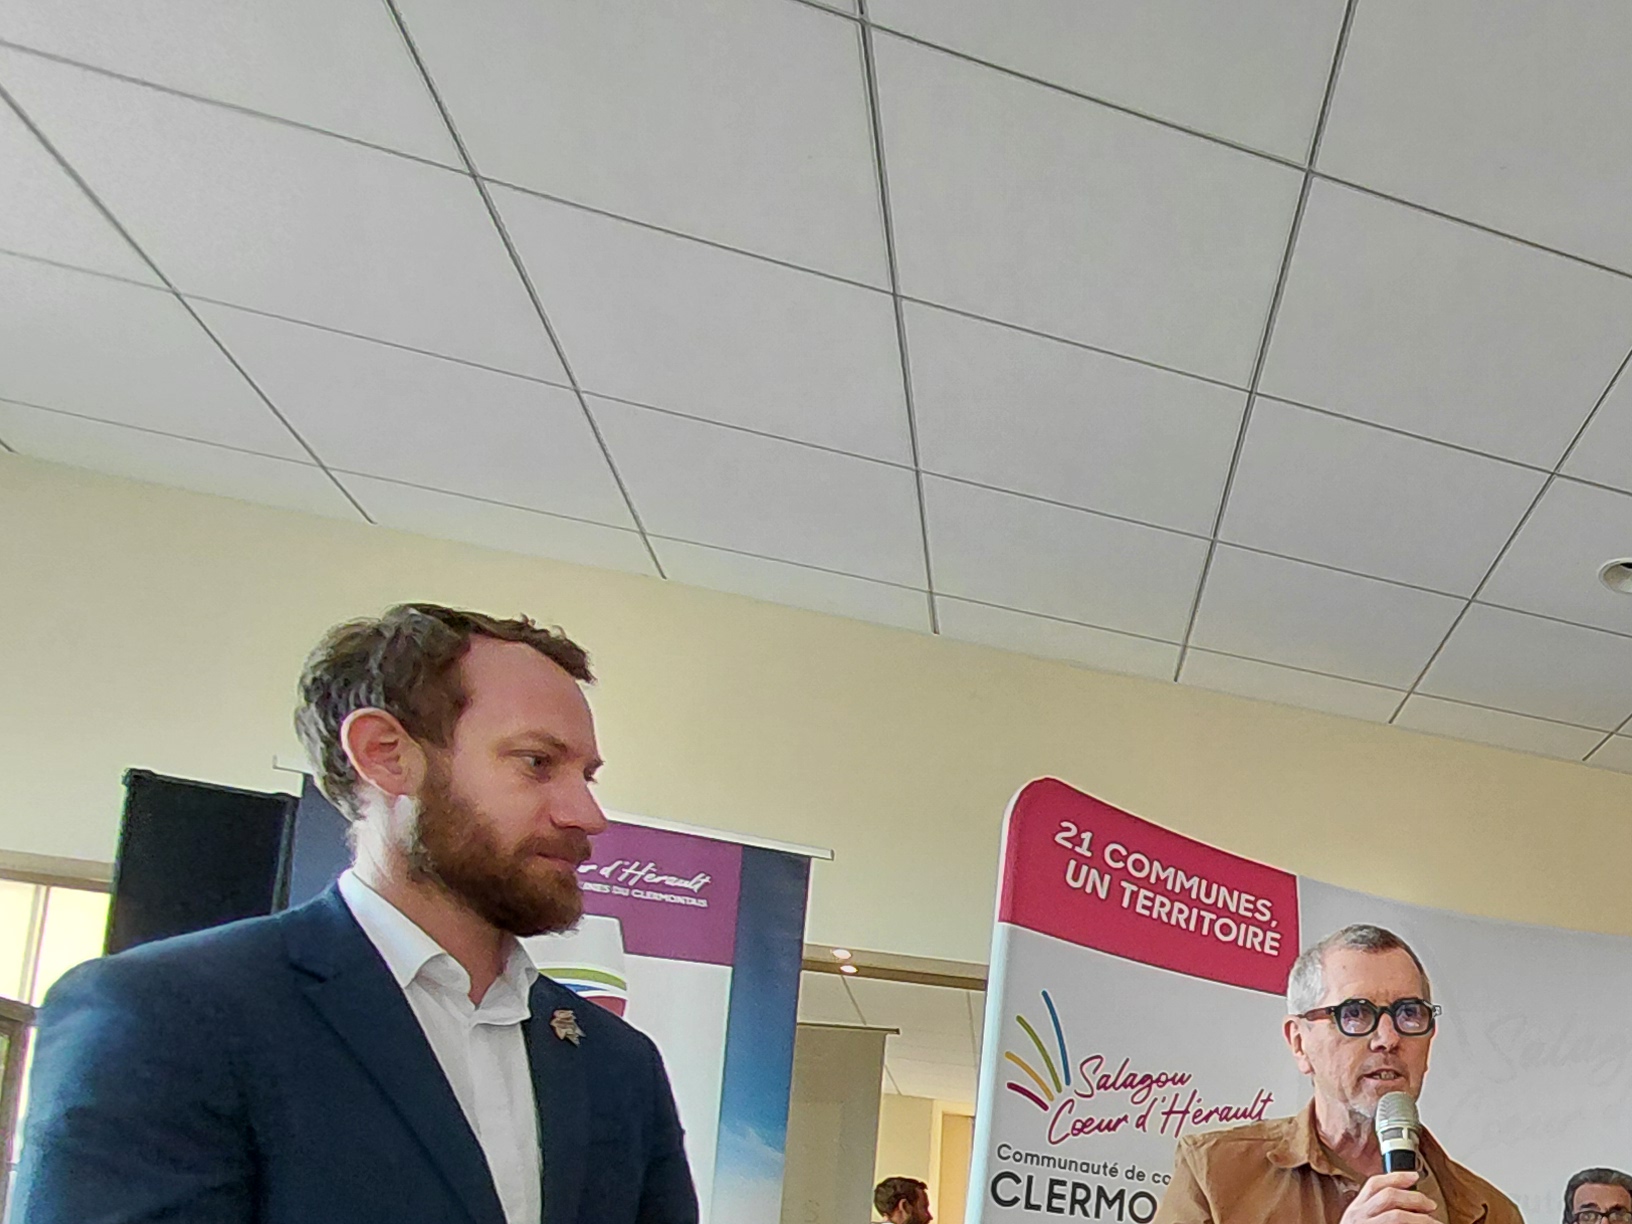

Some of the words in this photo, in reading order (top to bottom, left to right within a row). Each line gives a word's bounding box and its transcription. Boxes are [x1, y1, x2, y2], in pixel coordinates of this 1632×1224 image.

[1054, 821, 1093, 857] 21
[1103, 843, 1278, 928] COMMUNES,
[1065, 858, 1111, 900] UN
[1120, 880, 1282, 957] TERRITOIRE
[1074, 1054, 1192, 1105] Salagou
[1048, 1098, 1129, 1146] Cœur
[1135, 1088, 1274, 1139] d'Hérault
[996, 1144, 1119, 1178] Communauté
[1124, 1168, 1146, 1182] de
[990, 1171, 1158, 1224] CLERMO
